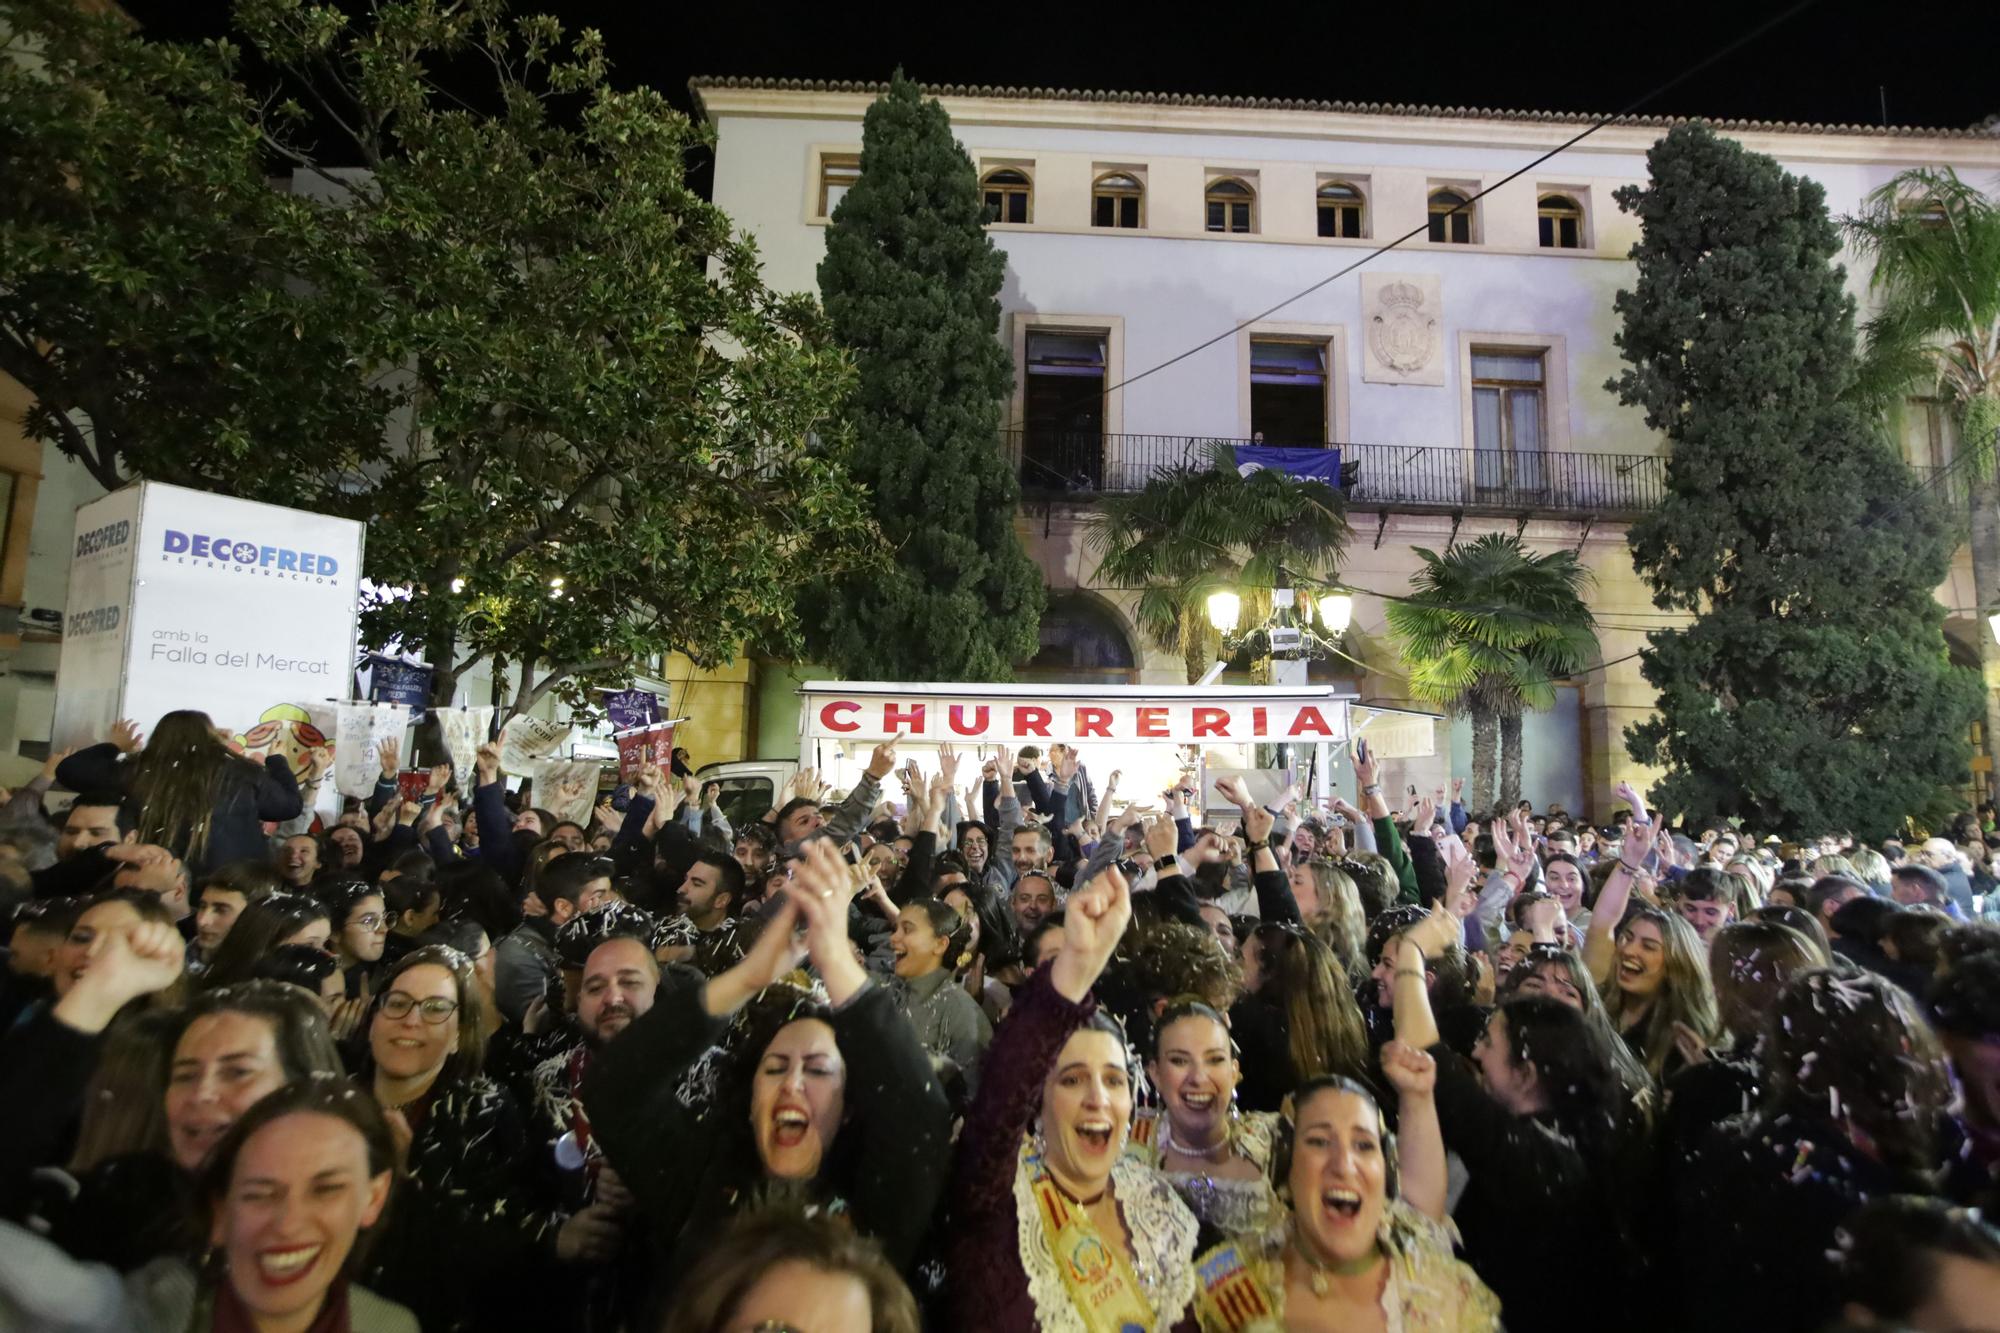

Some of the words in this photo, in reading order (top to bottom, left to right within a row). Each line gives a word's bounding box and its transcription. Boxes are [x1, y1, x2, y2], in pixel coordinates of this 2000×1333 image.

[163, 529, 339, 577] DECOFRED
[151, 629, 191, 643] amb
[195, 631, 209, 643] la
[151, 643, 208, 666] Falla
[215, 650, 249, 668] del
[256, 653, 331, 676] Mercat
[522, 715, 558, 742] Premi
[819, 700, 1334, 736] CHURRERIA
